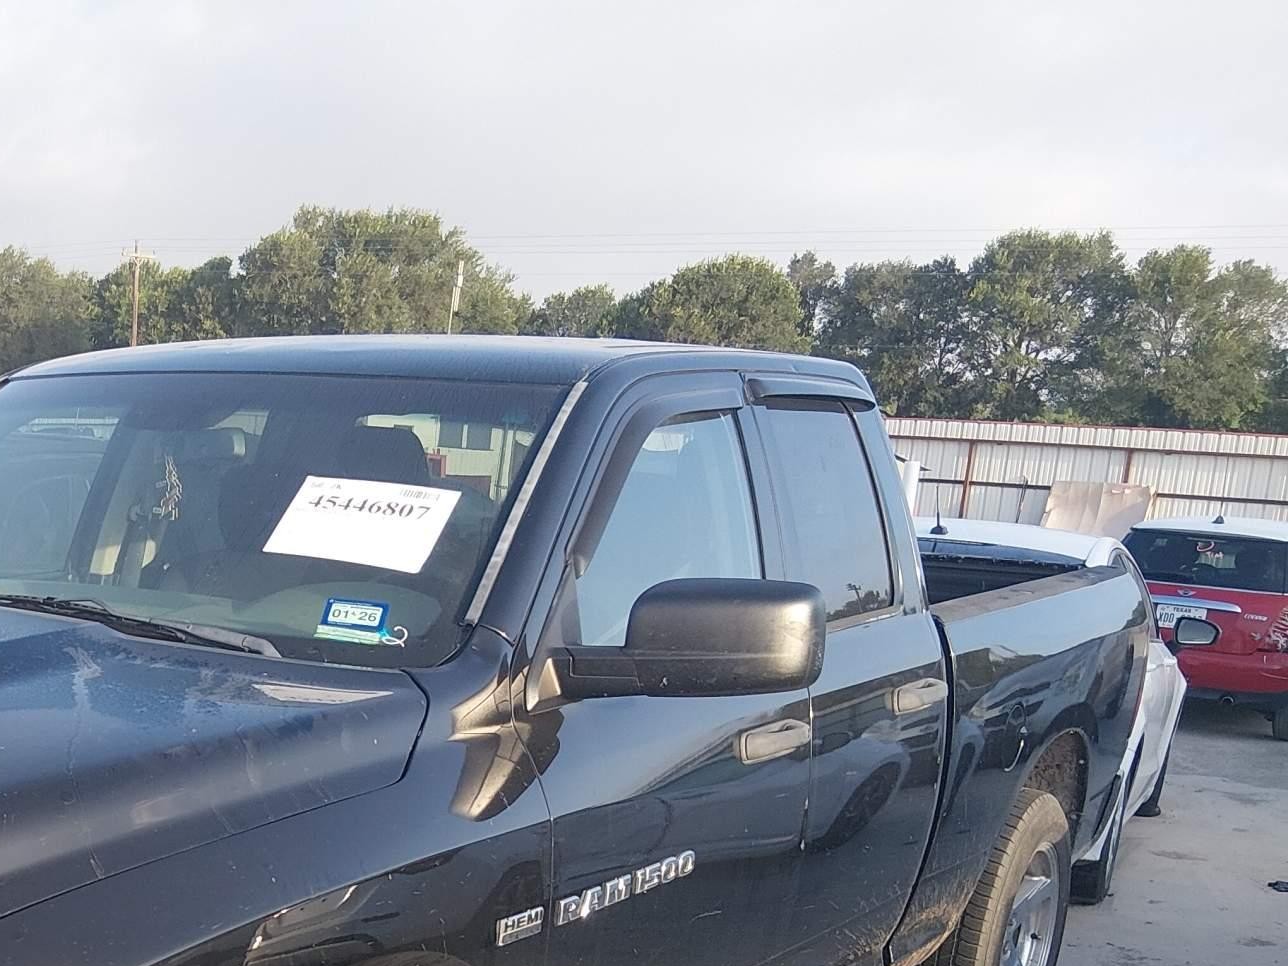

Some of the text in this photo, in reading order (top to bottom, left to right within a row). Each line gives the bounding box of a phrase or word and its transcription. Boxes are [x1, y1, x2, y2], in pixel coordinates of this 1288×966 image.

[308, 494, 431, 520] 45446807
[331, 608, 377, 622] 01 26
[554, 849, 696, 927] RAM 1500
